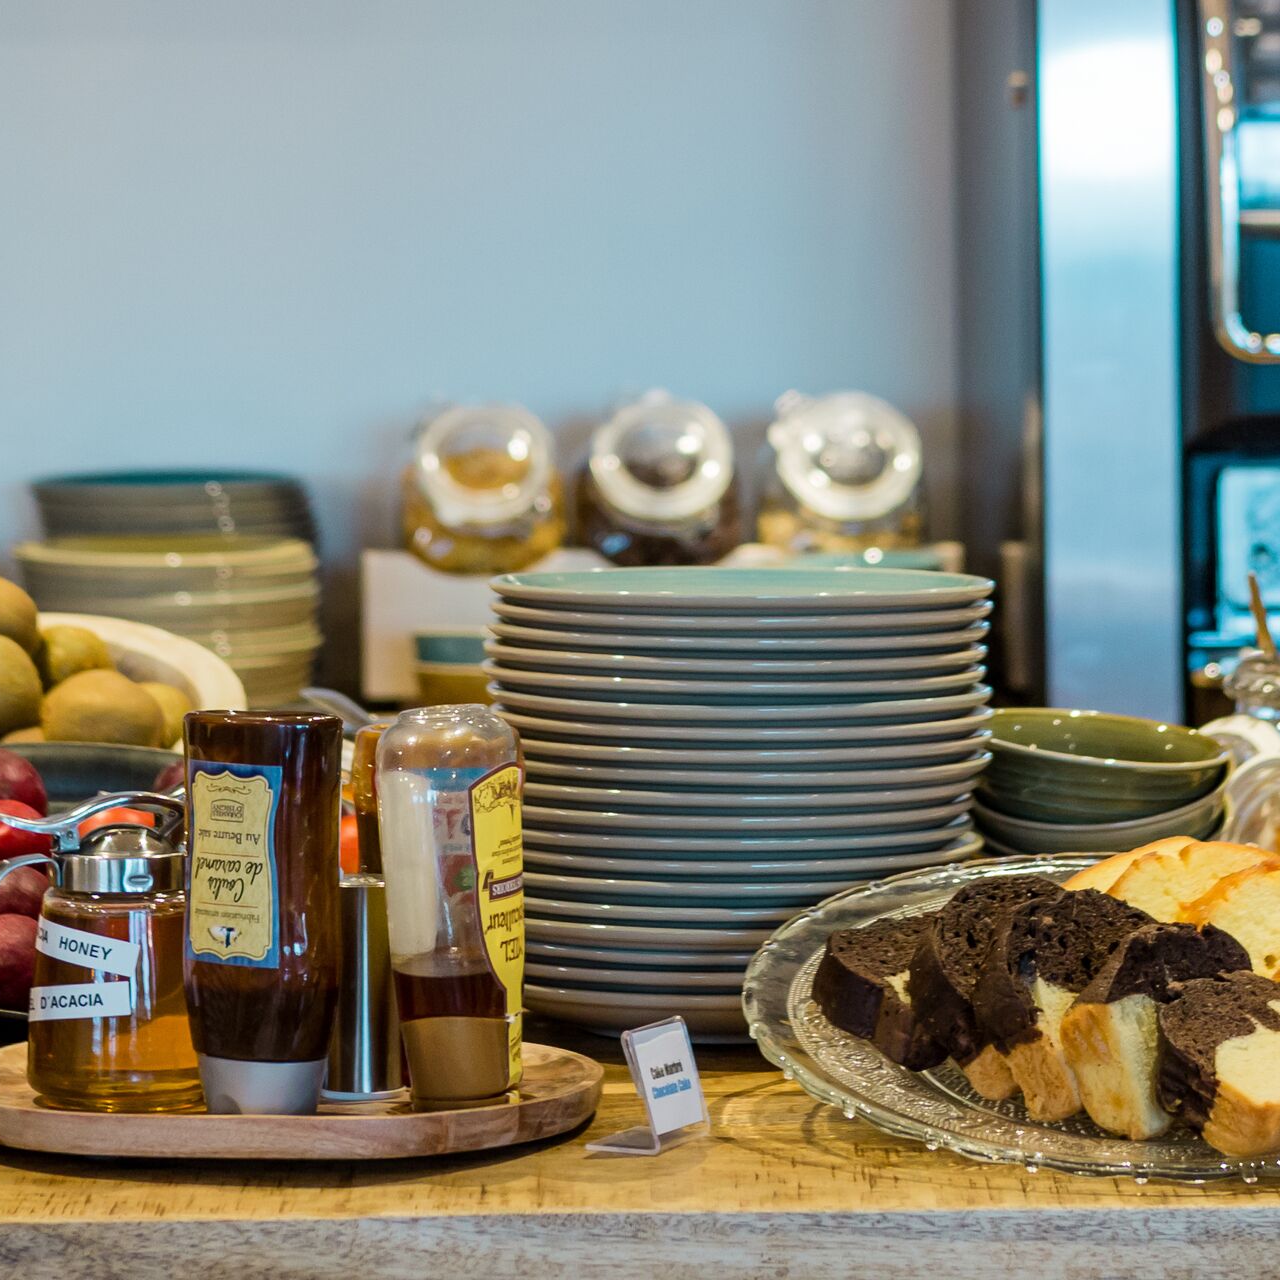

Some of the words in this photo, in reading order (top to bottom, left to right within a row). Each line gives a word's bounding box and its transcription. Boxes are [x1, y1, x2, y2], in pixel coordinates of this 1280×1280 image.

[214, 830, 242, 845] Beurre
[246, 833, 261, 846] Au
[195, 856, 241, 879] caramel
[245, 862, 263, 885] de
[208, 876, 244, 903] Coulis
[59, 936, 112, 960] HONEY
[41, 993, 104, 1010] D'ACACIA
